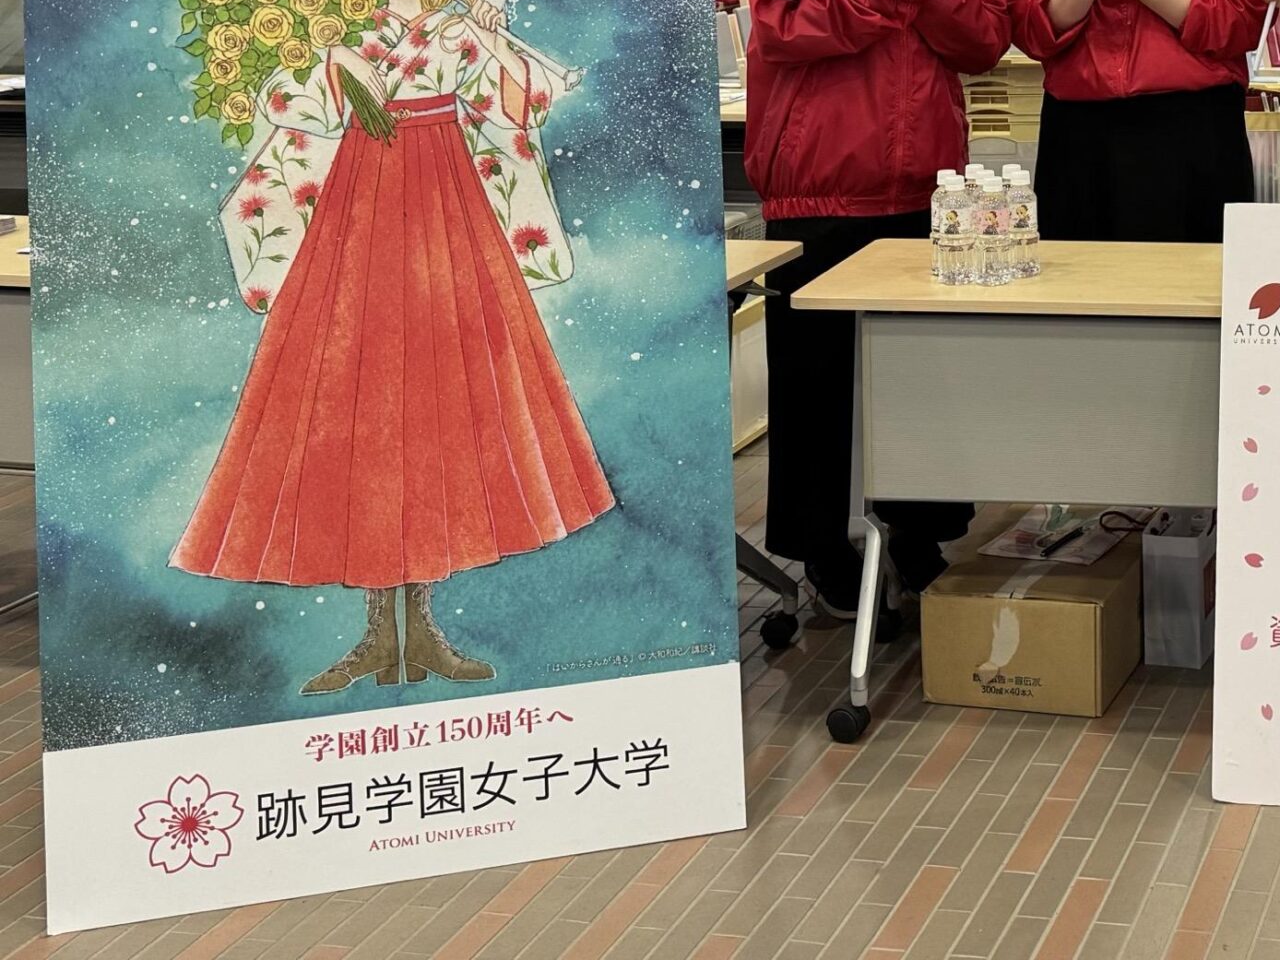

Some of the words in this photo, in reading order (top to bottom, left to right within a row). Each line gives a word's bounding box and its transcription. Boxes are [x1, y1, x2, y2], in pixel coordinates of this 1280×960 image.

[304, 706, 575, 762] 学園創立150周年へ
[256, 737, 671, 841] 跡見学園女子大学
